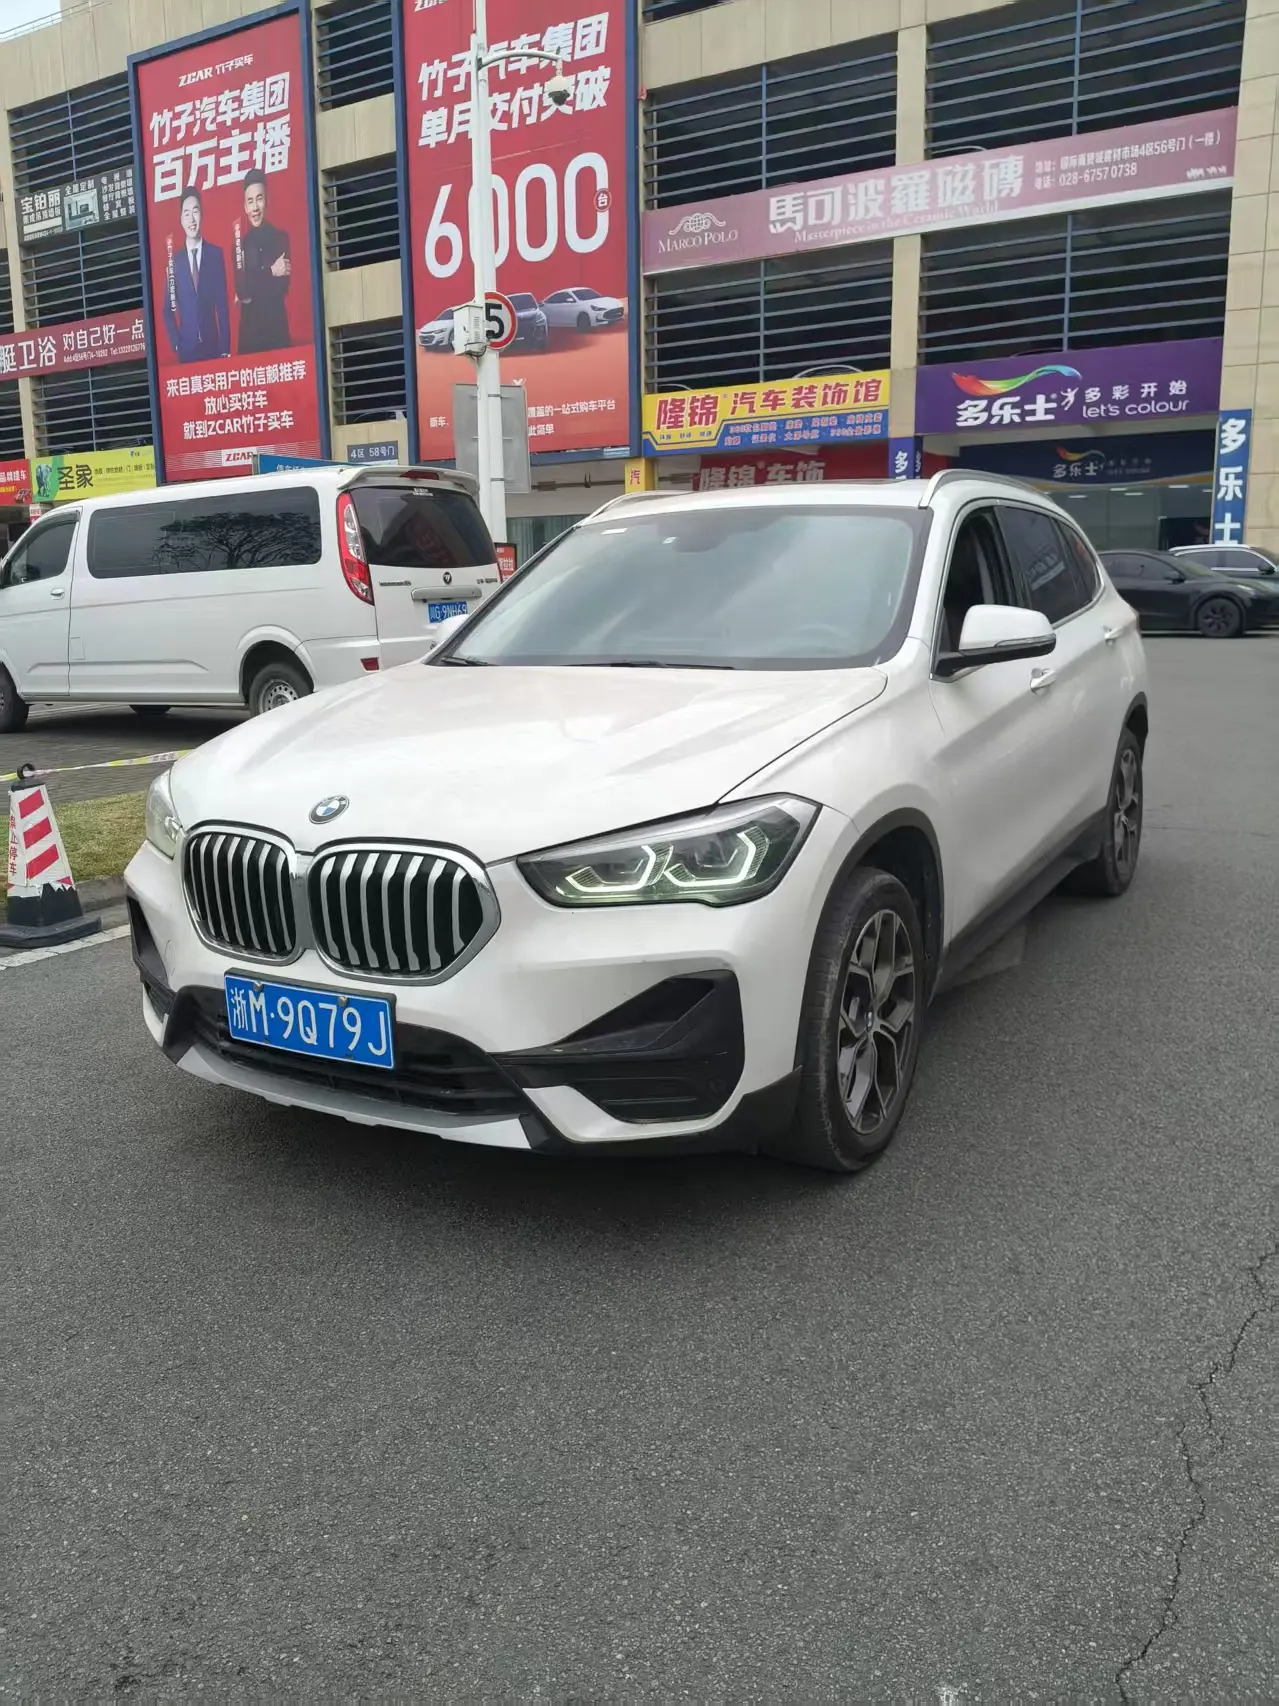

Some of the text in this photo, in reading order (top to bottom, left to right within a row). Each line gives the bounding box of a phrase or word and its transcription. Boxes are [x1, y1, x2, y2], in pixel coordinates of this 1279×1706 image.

[178, 53, 254, 88] ZCAR 竹子买车
[150, 71, 290, 148] 竹子汽车集团
[418, 65, 611, 149] 单月交付突破
[153, 113, 291, 203] 百万主播
[20, 188, 61, 215] 宝铂丽
[597, 192, 608, 208] 台
[768, 154, 1024, 234] 馬可波羅磁磚
[425, 152, 610, 279] 6000
[794, 200, 999, 244] Masterpiece in the Ceramic World
[658, 229, 738, 253] MARCO POLO
[62, 318, 145, 351] 对自己好一点
[485, 302, 505, 340] 5
[166, 360, 307, 398] 来自真实用户的信赖推荐
[1084, 379, 1188, 403] 多彩开始
[204, 390, 268, 416] 放心买好车
[655, 394, 719, 431] 隆锦
[730, 378, 882, 416] 汽车装饰馆
[956, 394, 1058, 427] 多乐士
[1082, 399, 1190, 419] let's colour
[183, 410, 294, 440] 就到ZCAR竹子买车
[350, 445, 395, 459] 4区 58号门
[57, 463, 94, 491] 圣象
[630, 468, 641, 486] 汽
[1052, 462, 1098, 479] 多乐士
[1214, 418, 1247, 545] 多乐士
[8, 815, 19, 876] 禁止停车
[230, 987, 387, 1056] 浙M·9Q79J
